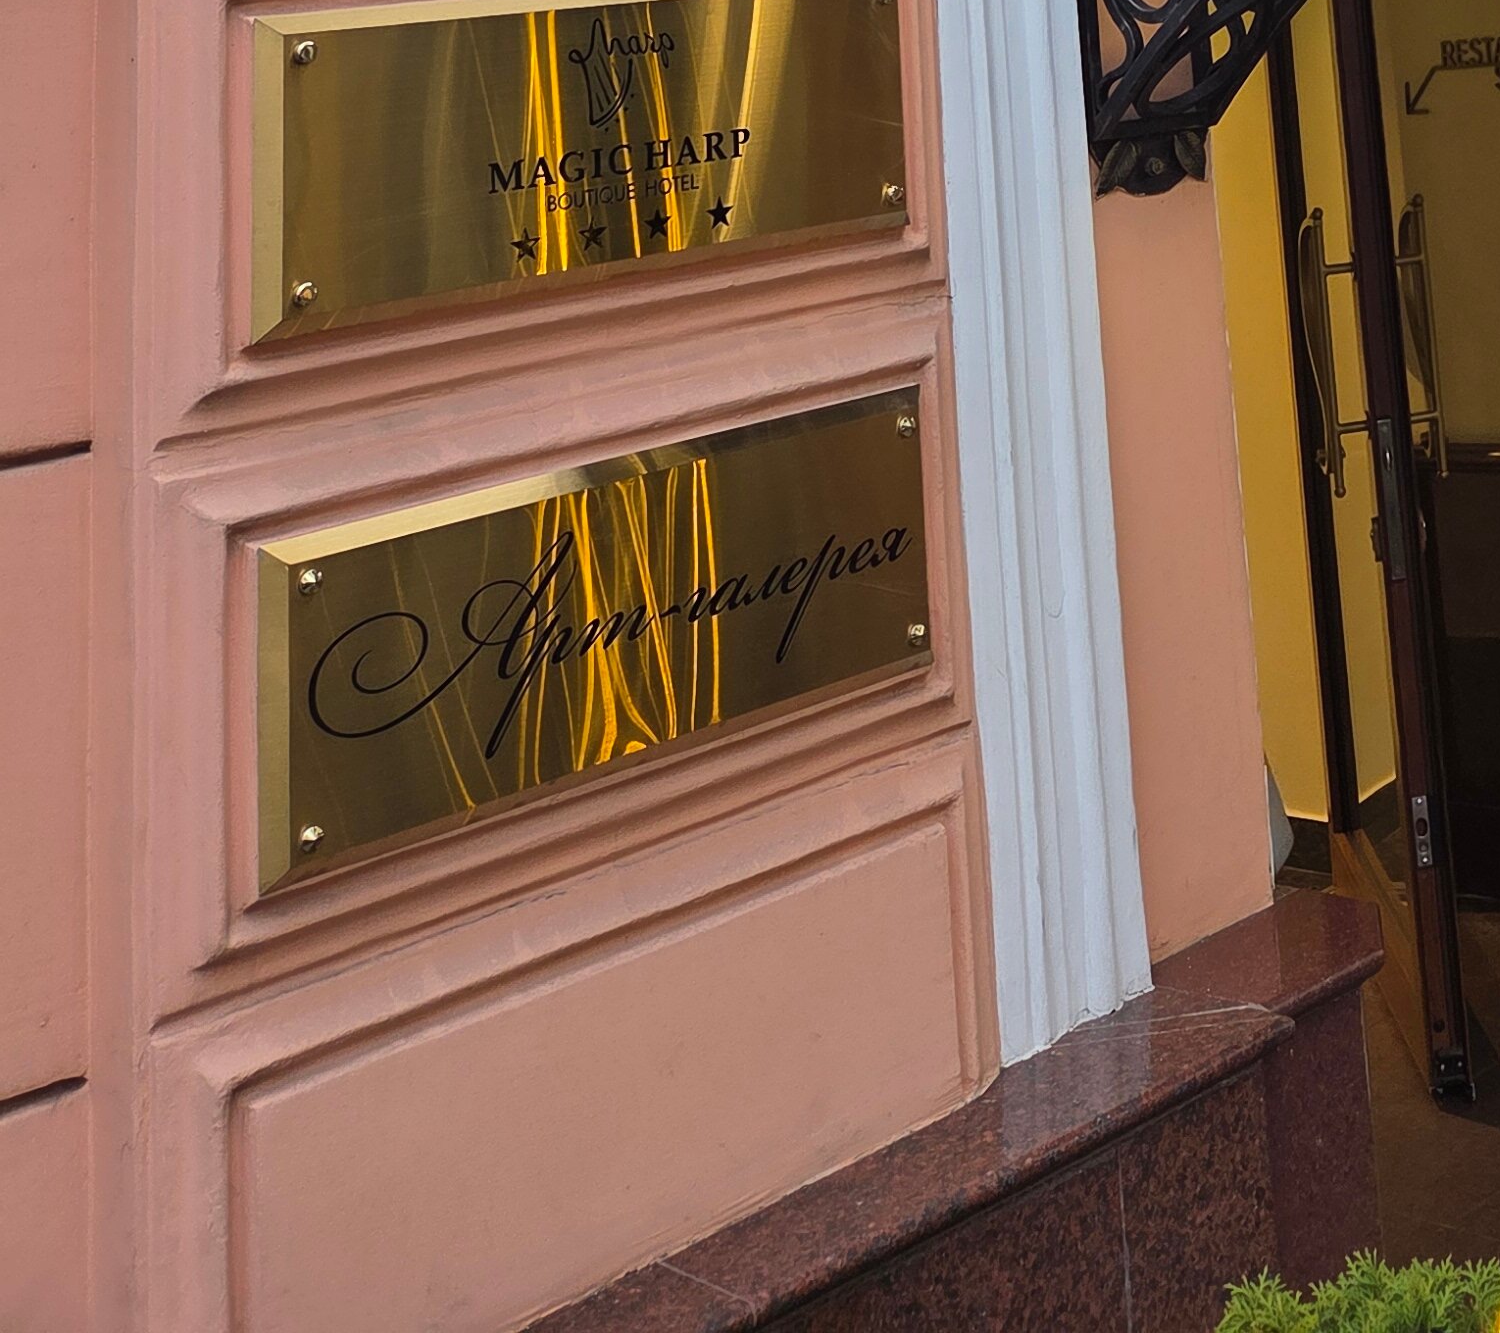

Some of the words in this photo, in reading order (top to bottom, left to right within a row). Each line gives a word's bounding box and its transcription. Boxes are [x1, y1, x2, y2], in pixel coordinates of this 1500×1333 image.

[487, 143, 634, 195] MAGIC
[644, 127, 751, 174] HARP
[546, 181, 637, 213] BOUTIQUE
[645, 172, 700, 198] HOTEL
[308, 526, 912, 761] Арт-галерея
